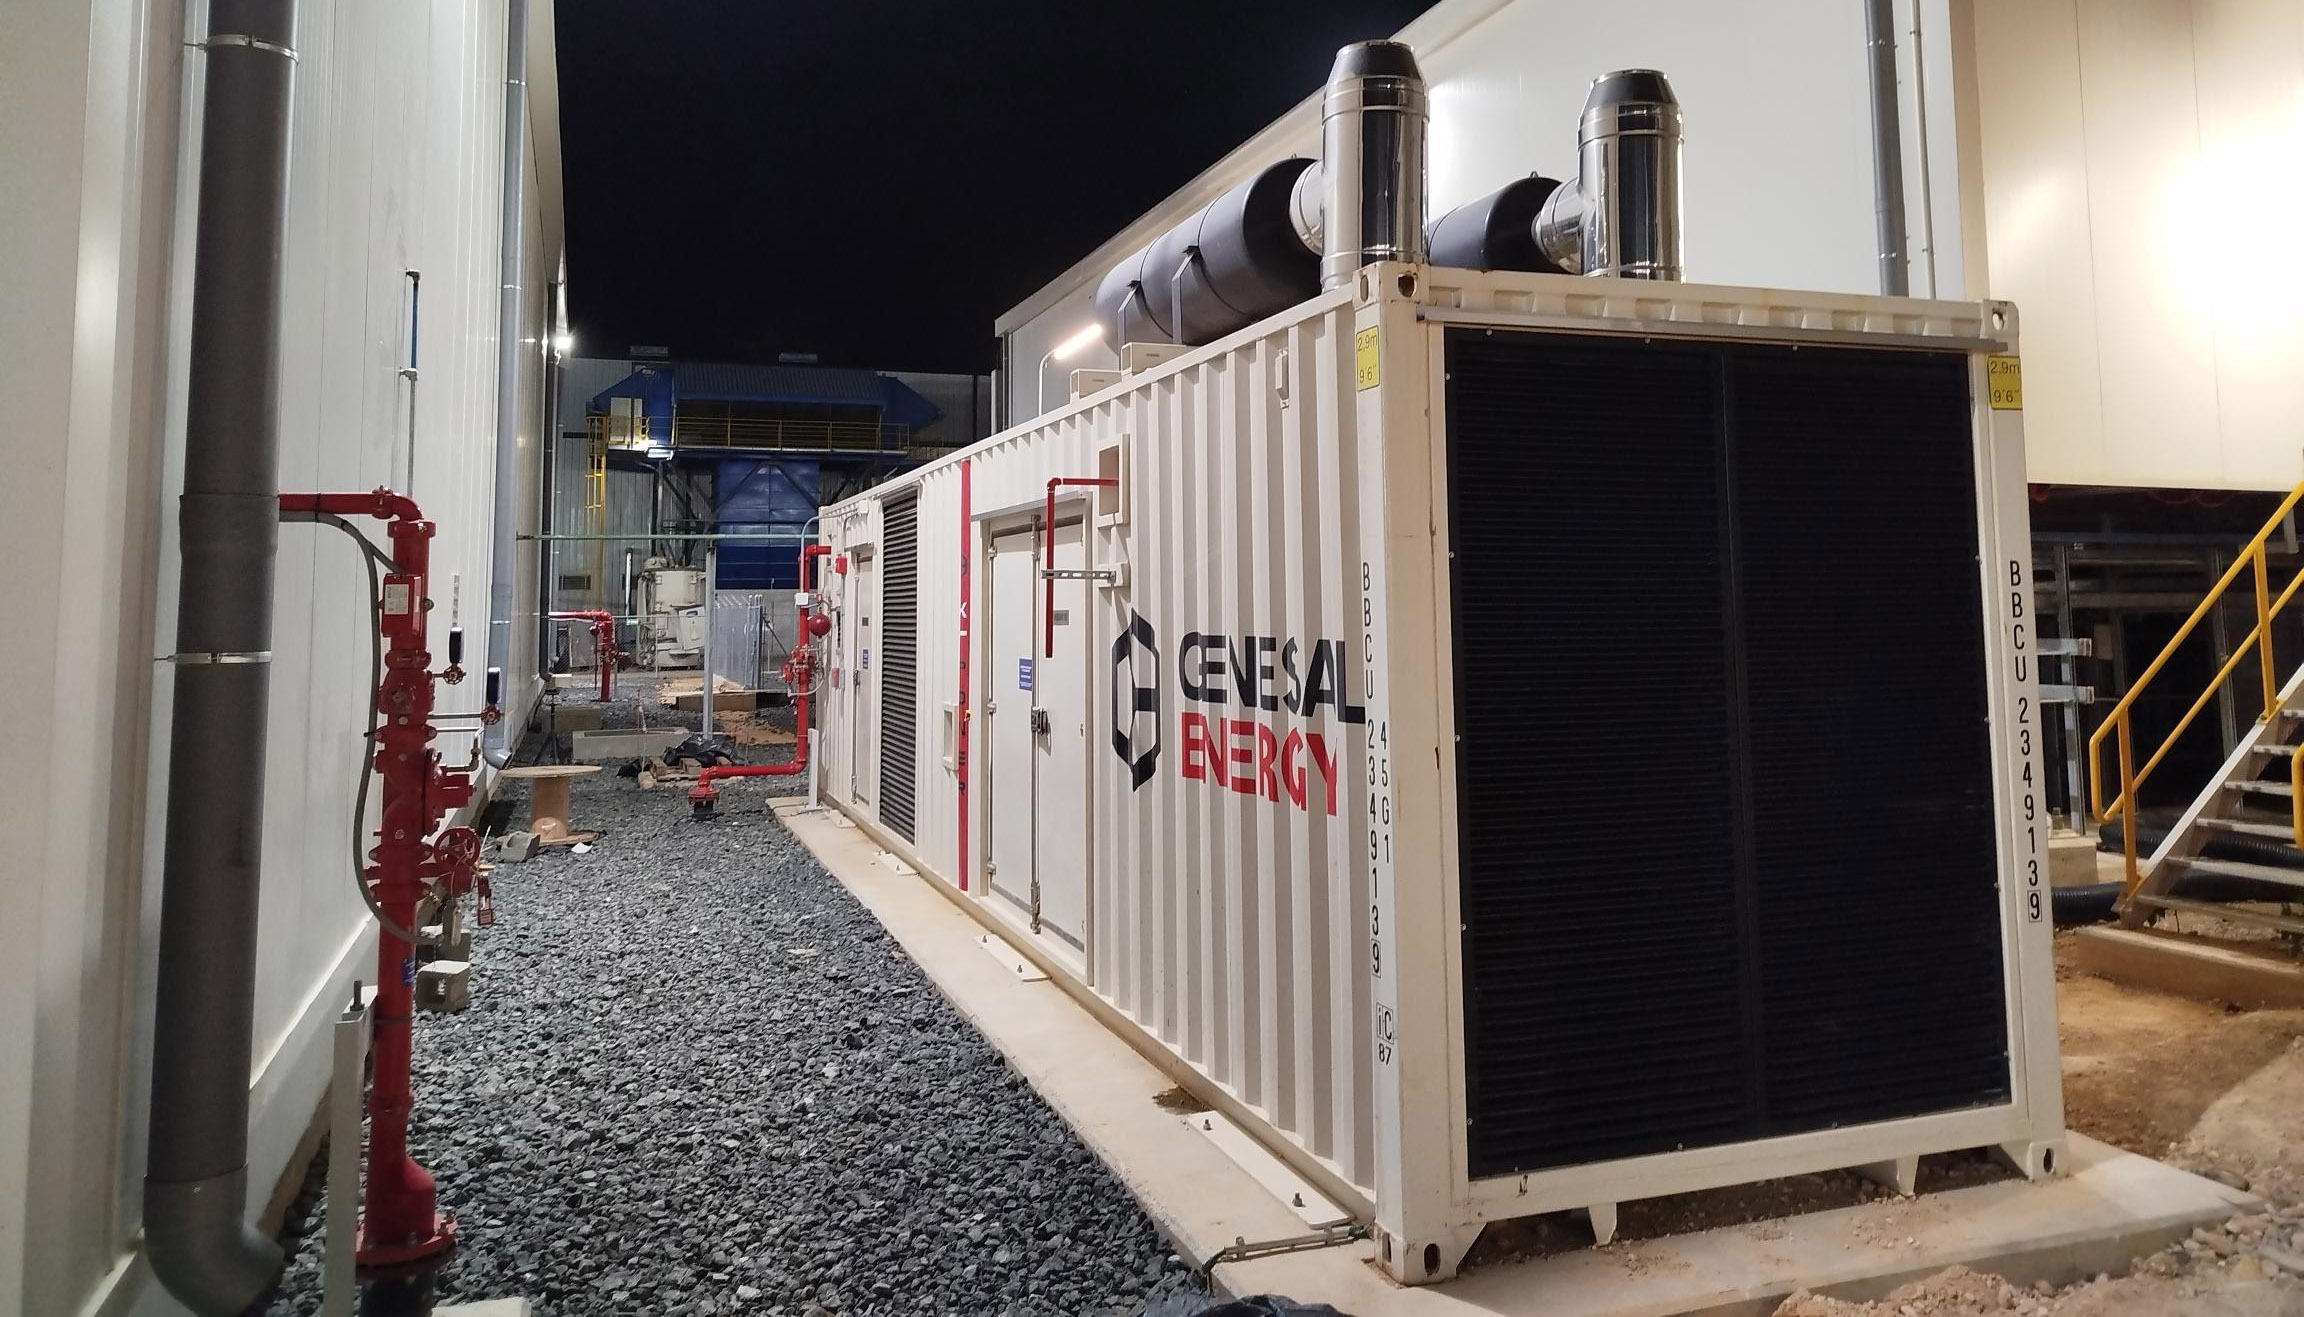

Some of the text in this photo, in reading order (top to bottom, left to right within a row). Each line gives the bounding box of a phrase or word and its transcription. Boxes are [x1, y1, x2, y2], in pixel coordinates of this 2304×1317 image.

[1178, 631, 1366, 725] GENESAL
[1362, 562, 1374, 700] BBCU
[2009, 560, 2028, 683] BBCU
[1181, 711, 1338, 817] ENERGY
[1380, 721, 1391, 864] 45G1
[1378, 1042, 1392, 1066] 87
